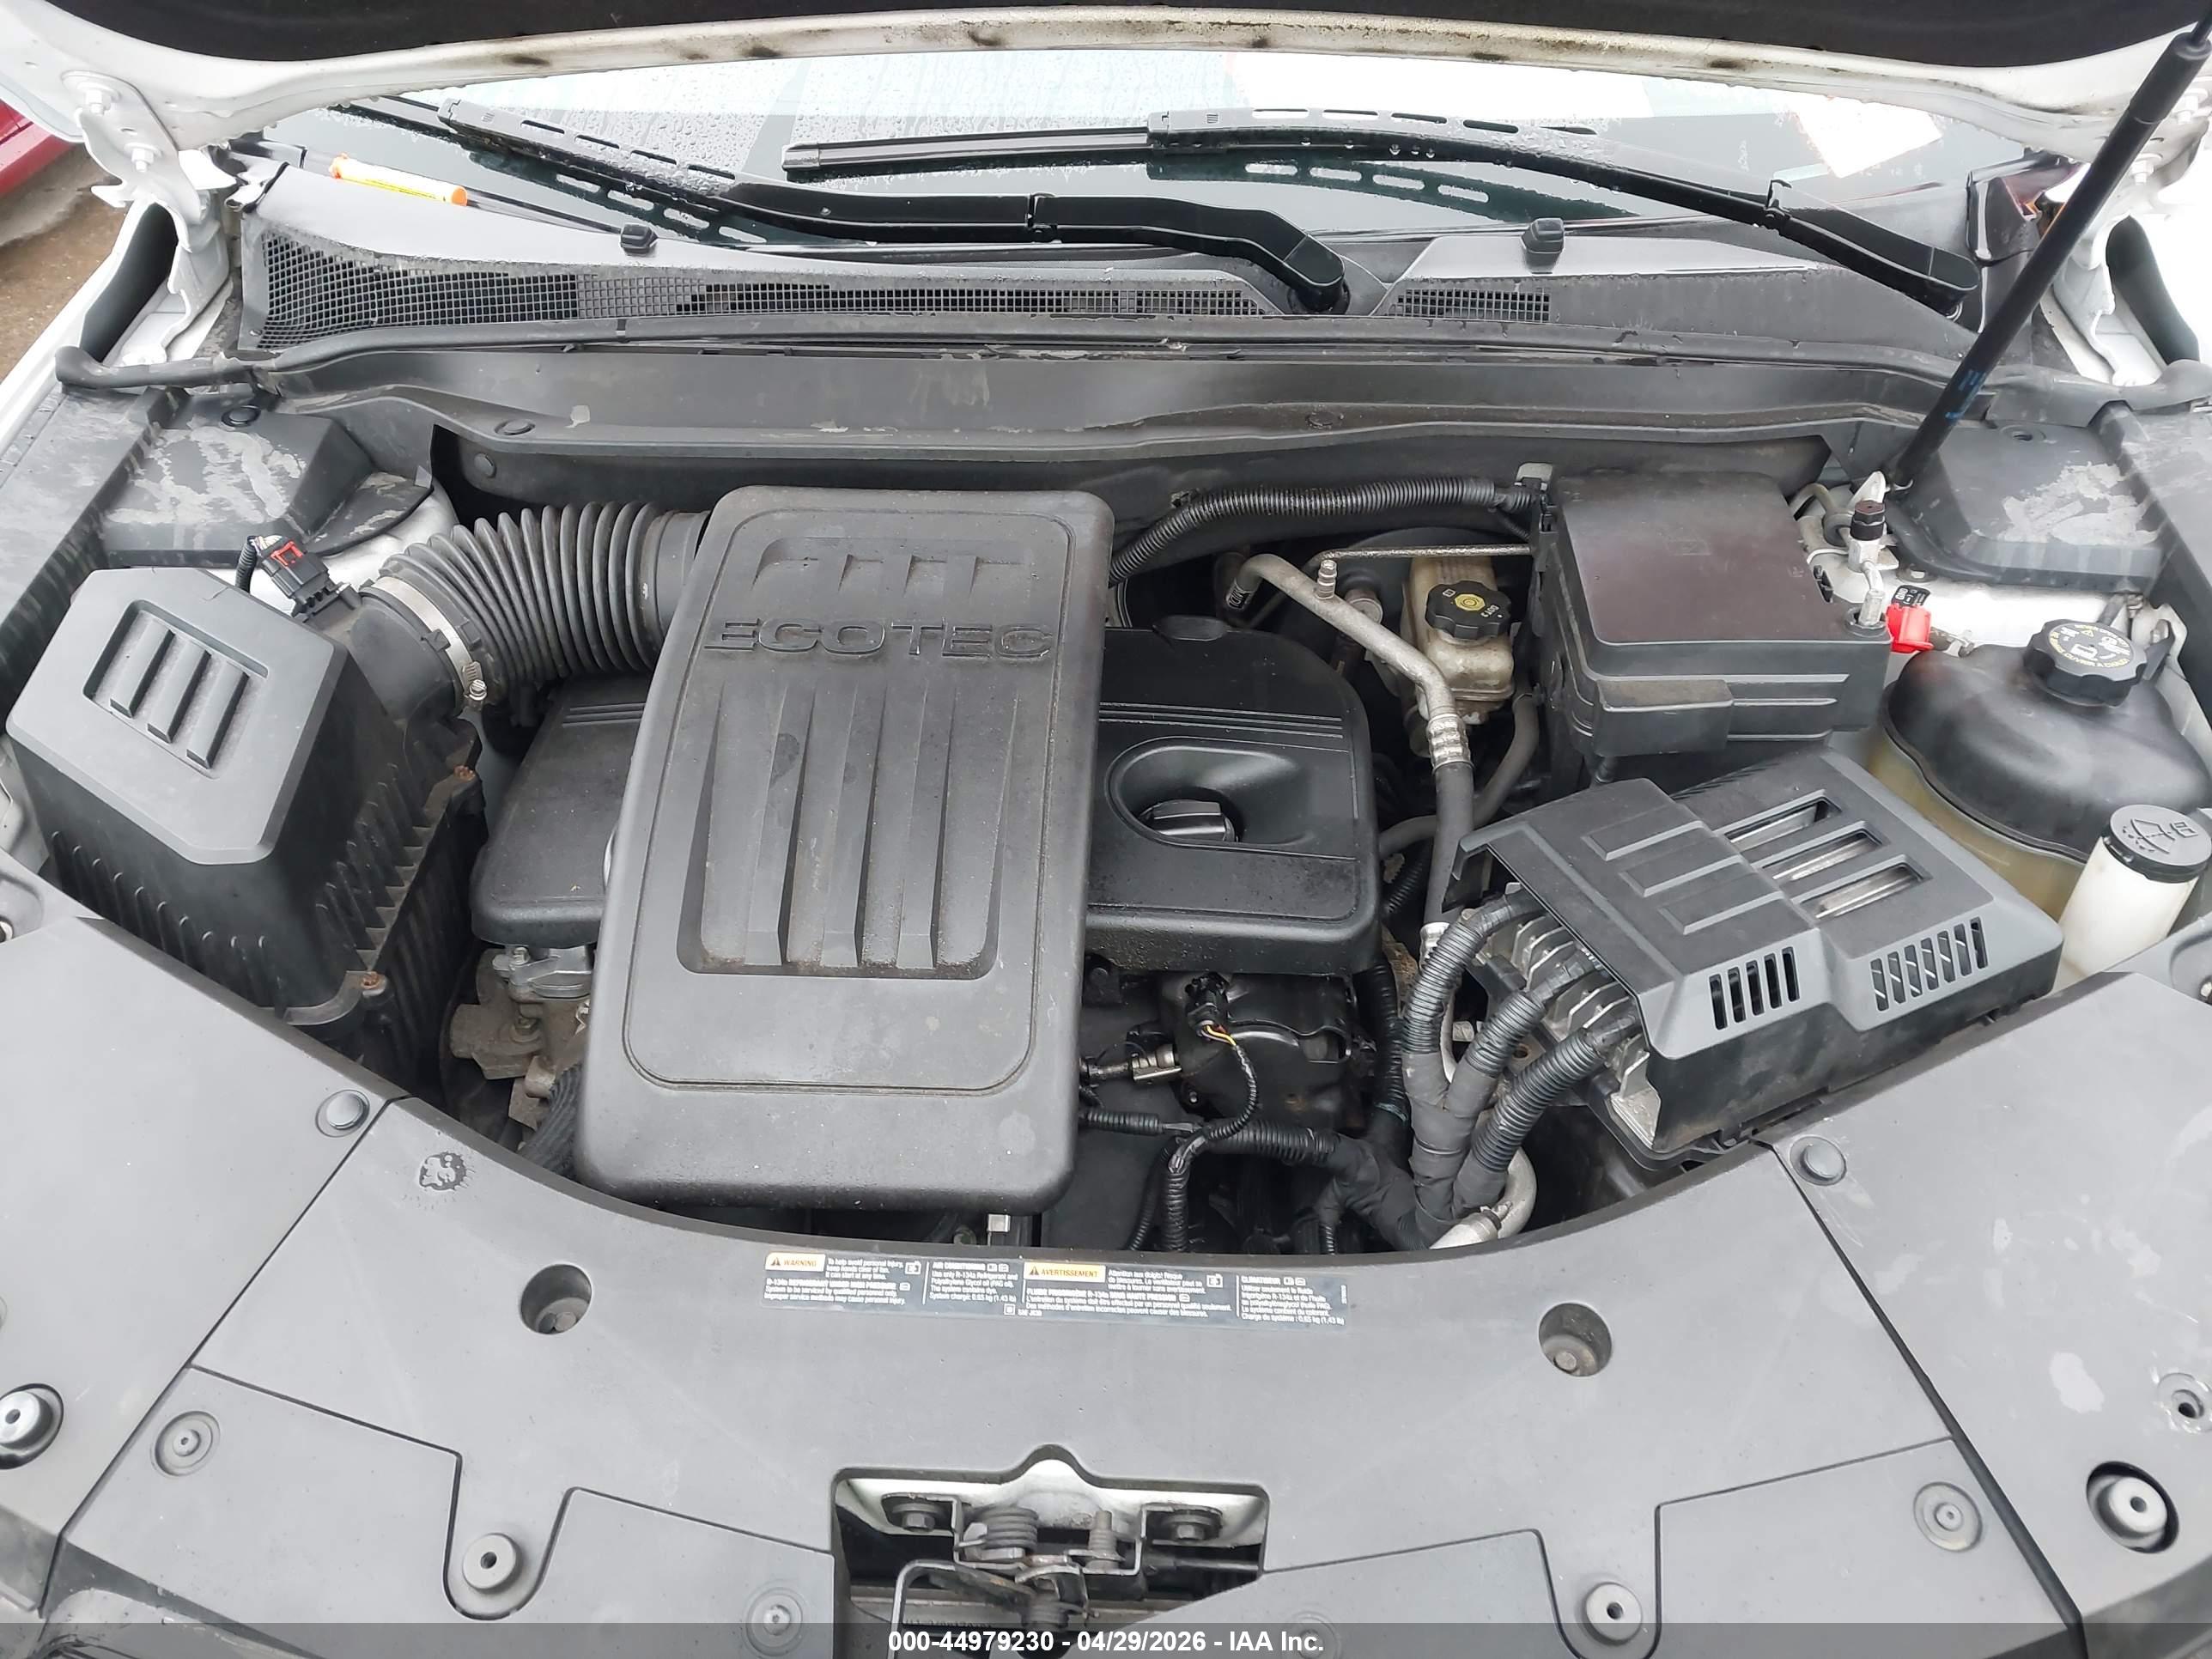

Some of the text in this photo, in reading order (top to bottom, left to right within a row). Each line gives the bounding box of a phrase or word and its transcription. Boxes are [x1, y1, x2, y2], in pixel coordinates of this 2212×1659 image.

[1894, 587, 1909, 600] GND
[703, 618, 1054, 659] ECOTEC
[1042, 1268, 1098, 1278] AVERTISSEMENT
[1108, 1269, 1133, 1278] Attention
[1241, 1312, 1262, 1322] Charge
